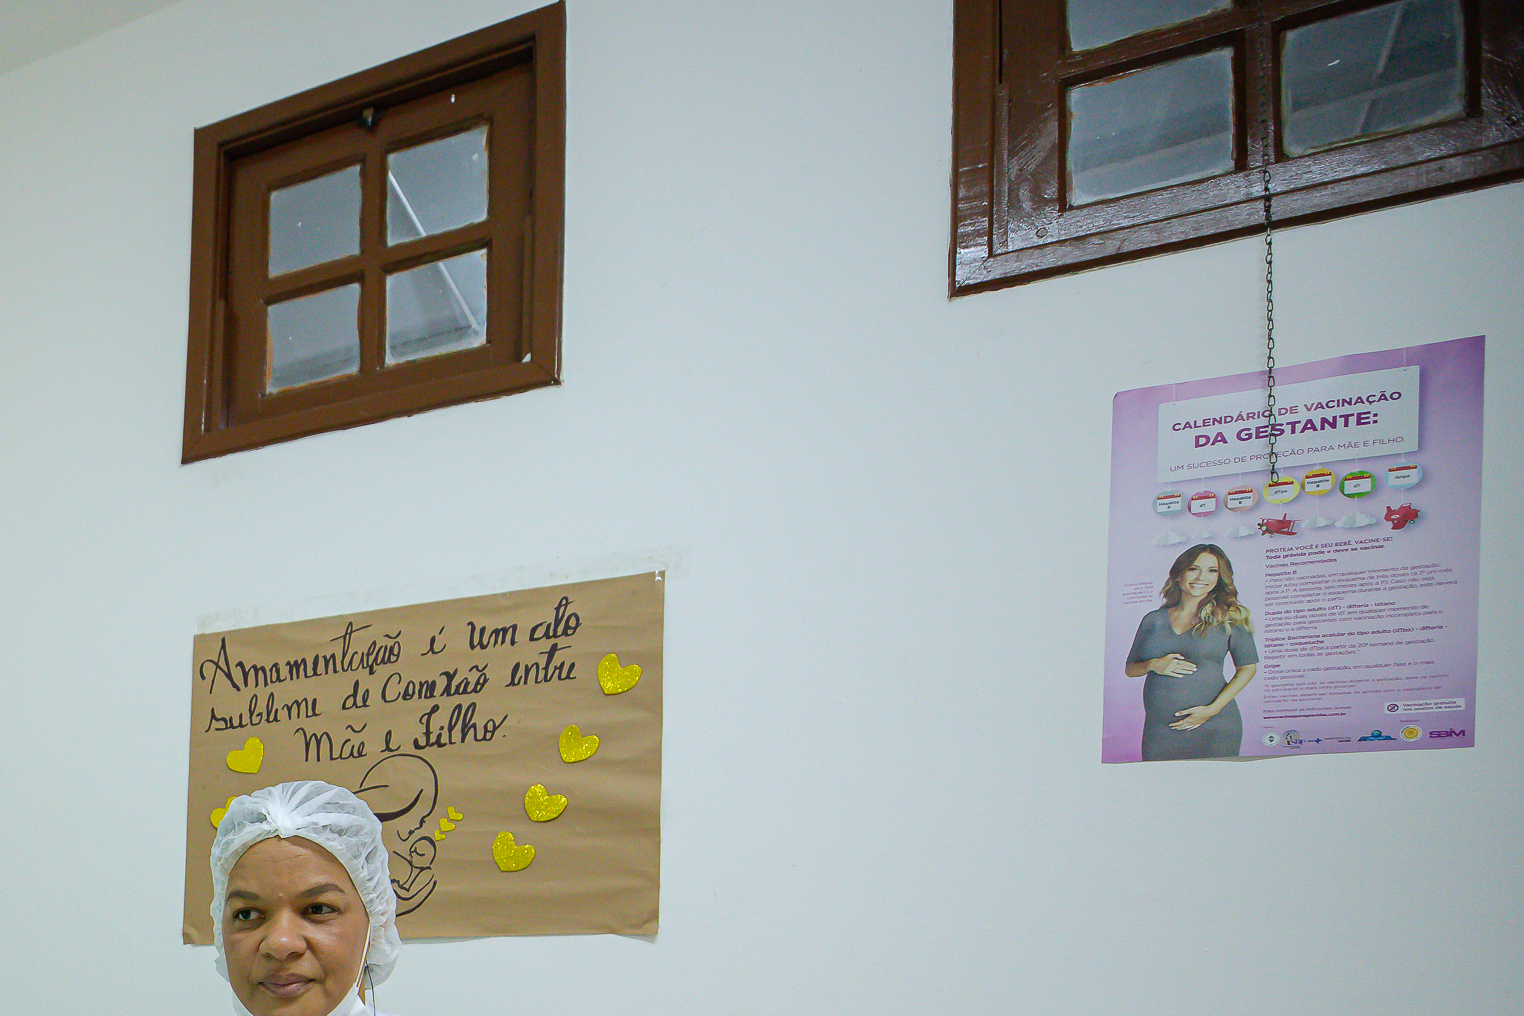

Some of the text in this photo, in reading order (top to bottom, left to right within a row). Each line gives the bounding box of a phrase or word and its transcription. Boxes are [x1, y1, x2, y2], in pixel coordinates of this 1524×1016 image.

[1172, 391, 1402, 432] CALENDÁRIO DE VACINAÇÃO
[1195, 412, 1378, 448] DA GESTANTE:
[1187, 458, 1231, 470] SUCESSO
[1307, 445, 1334, 455] PARA
[1338, 441, 1360, 450] MÃE
[1372, 436, 1405, 445] FILHO.
[1290, 558, 1337, 566] Recomendadas
[342, 678, 370, 712] de
